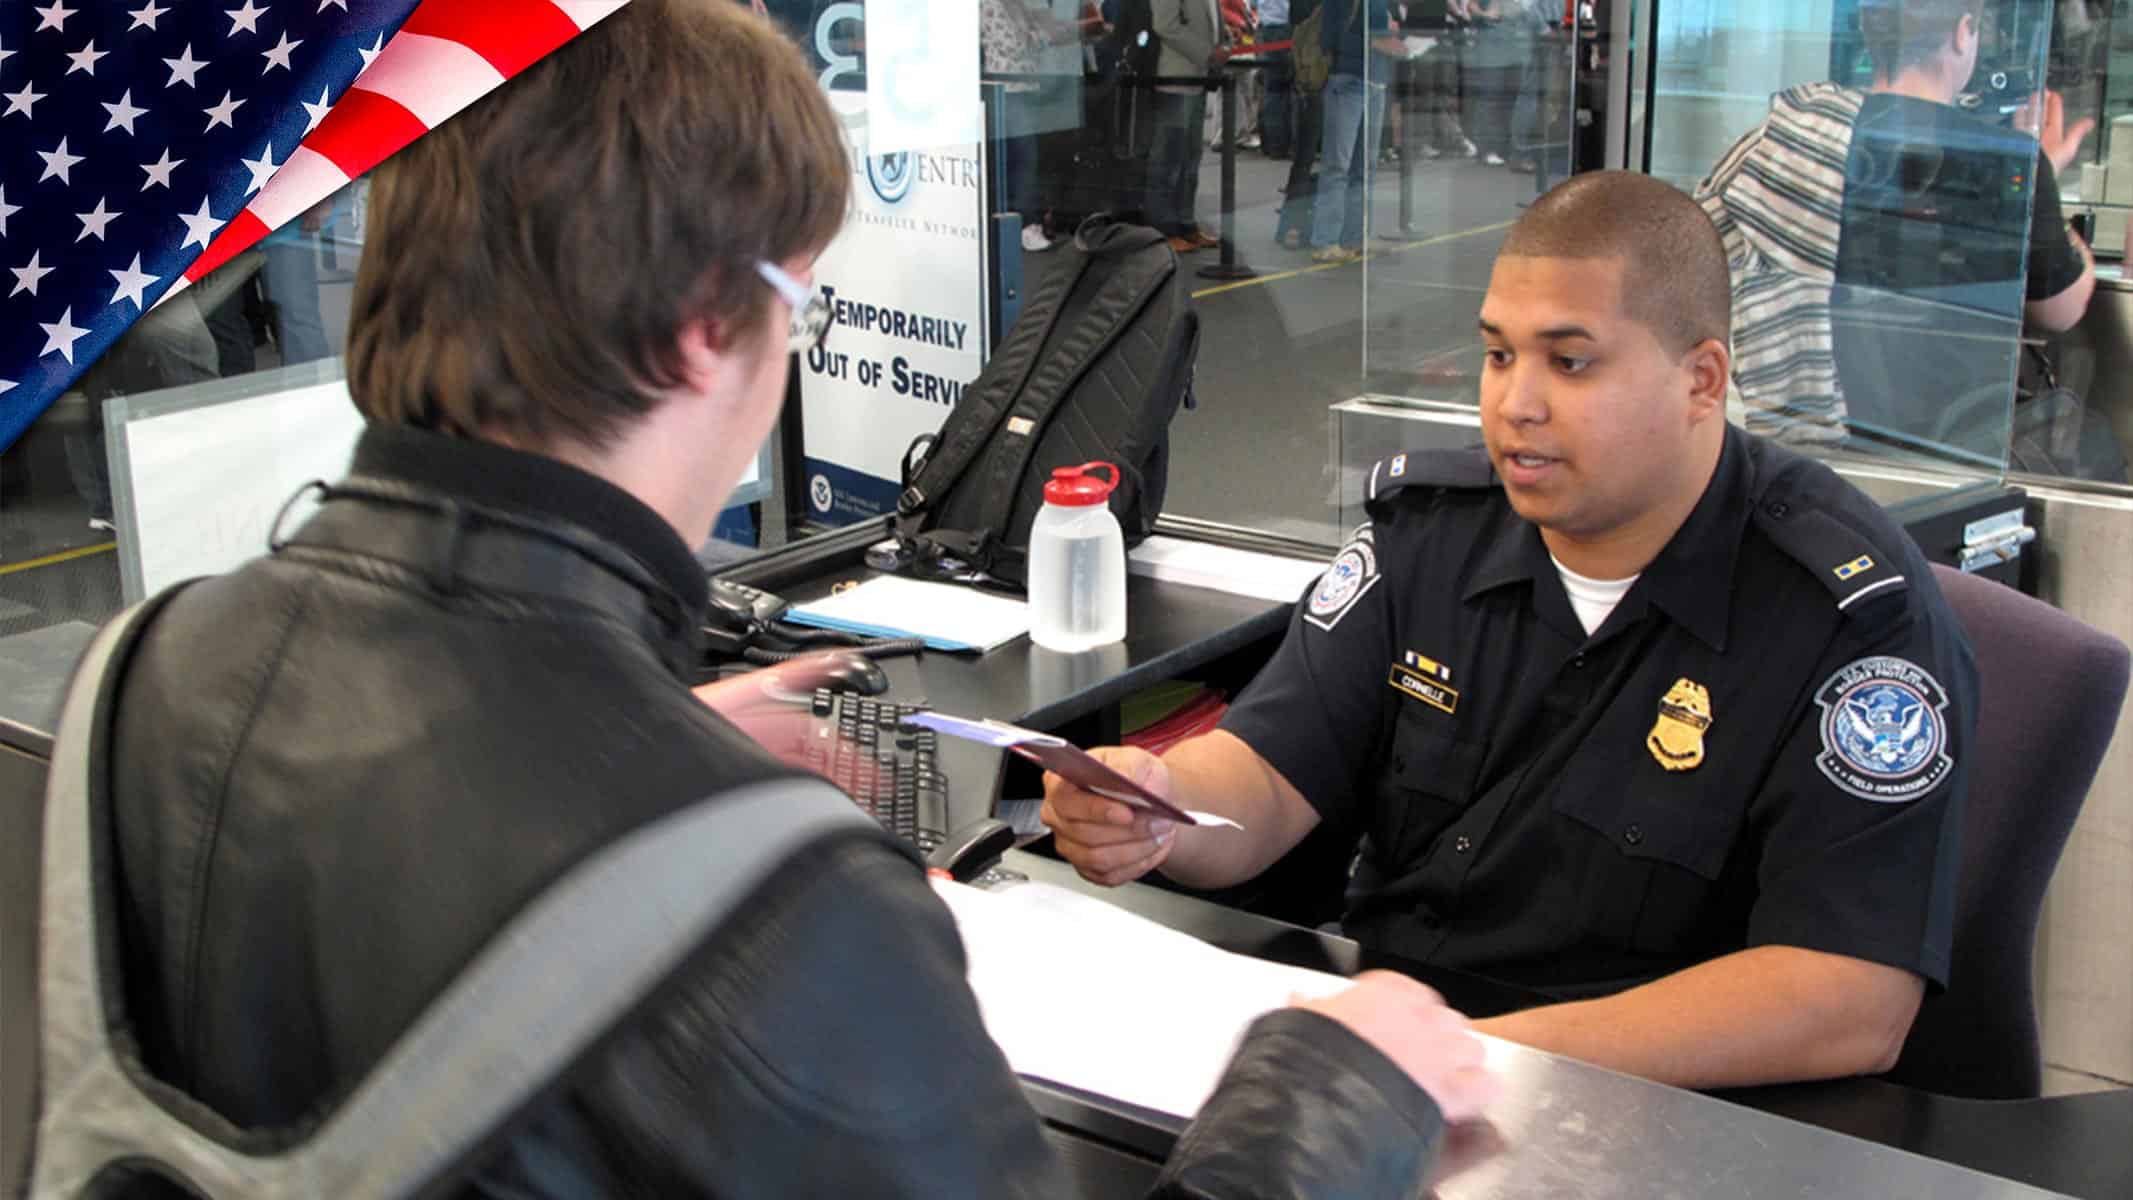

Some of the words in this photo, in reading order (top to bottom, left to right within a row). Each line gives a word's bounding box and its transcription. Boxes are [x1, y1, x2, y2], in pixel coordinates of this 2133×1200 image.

[821, 285, 966, 350] TEMPORARILY
[808, 345, 848, 380] OUT
[858, 359, 882, 388] OF
[1847, 774, 1873, 792] FIELD
[1874, 776, 1929, 794] OPERATIONS
